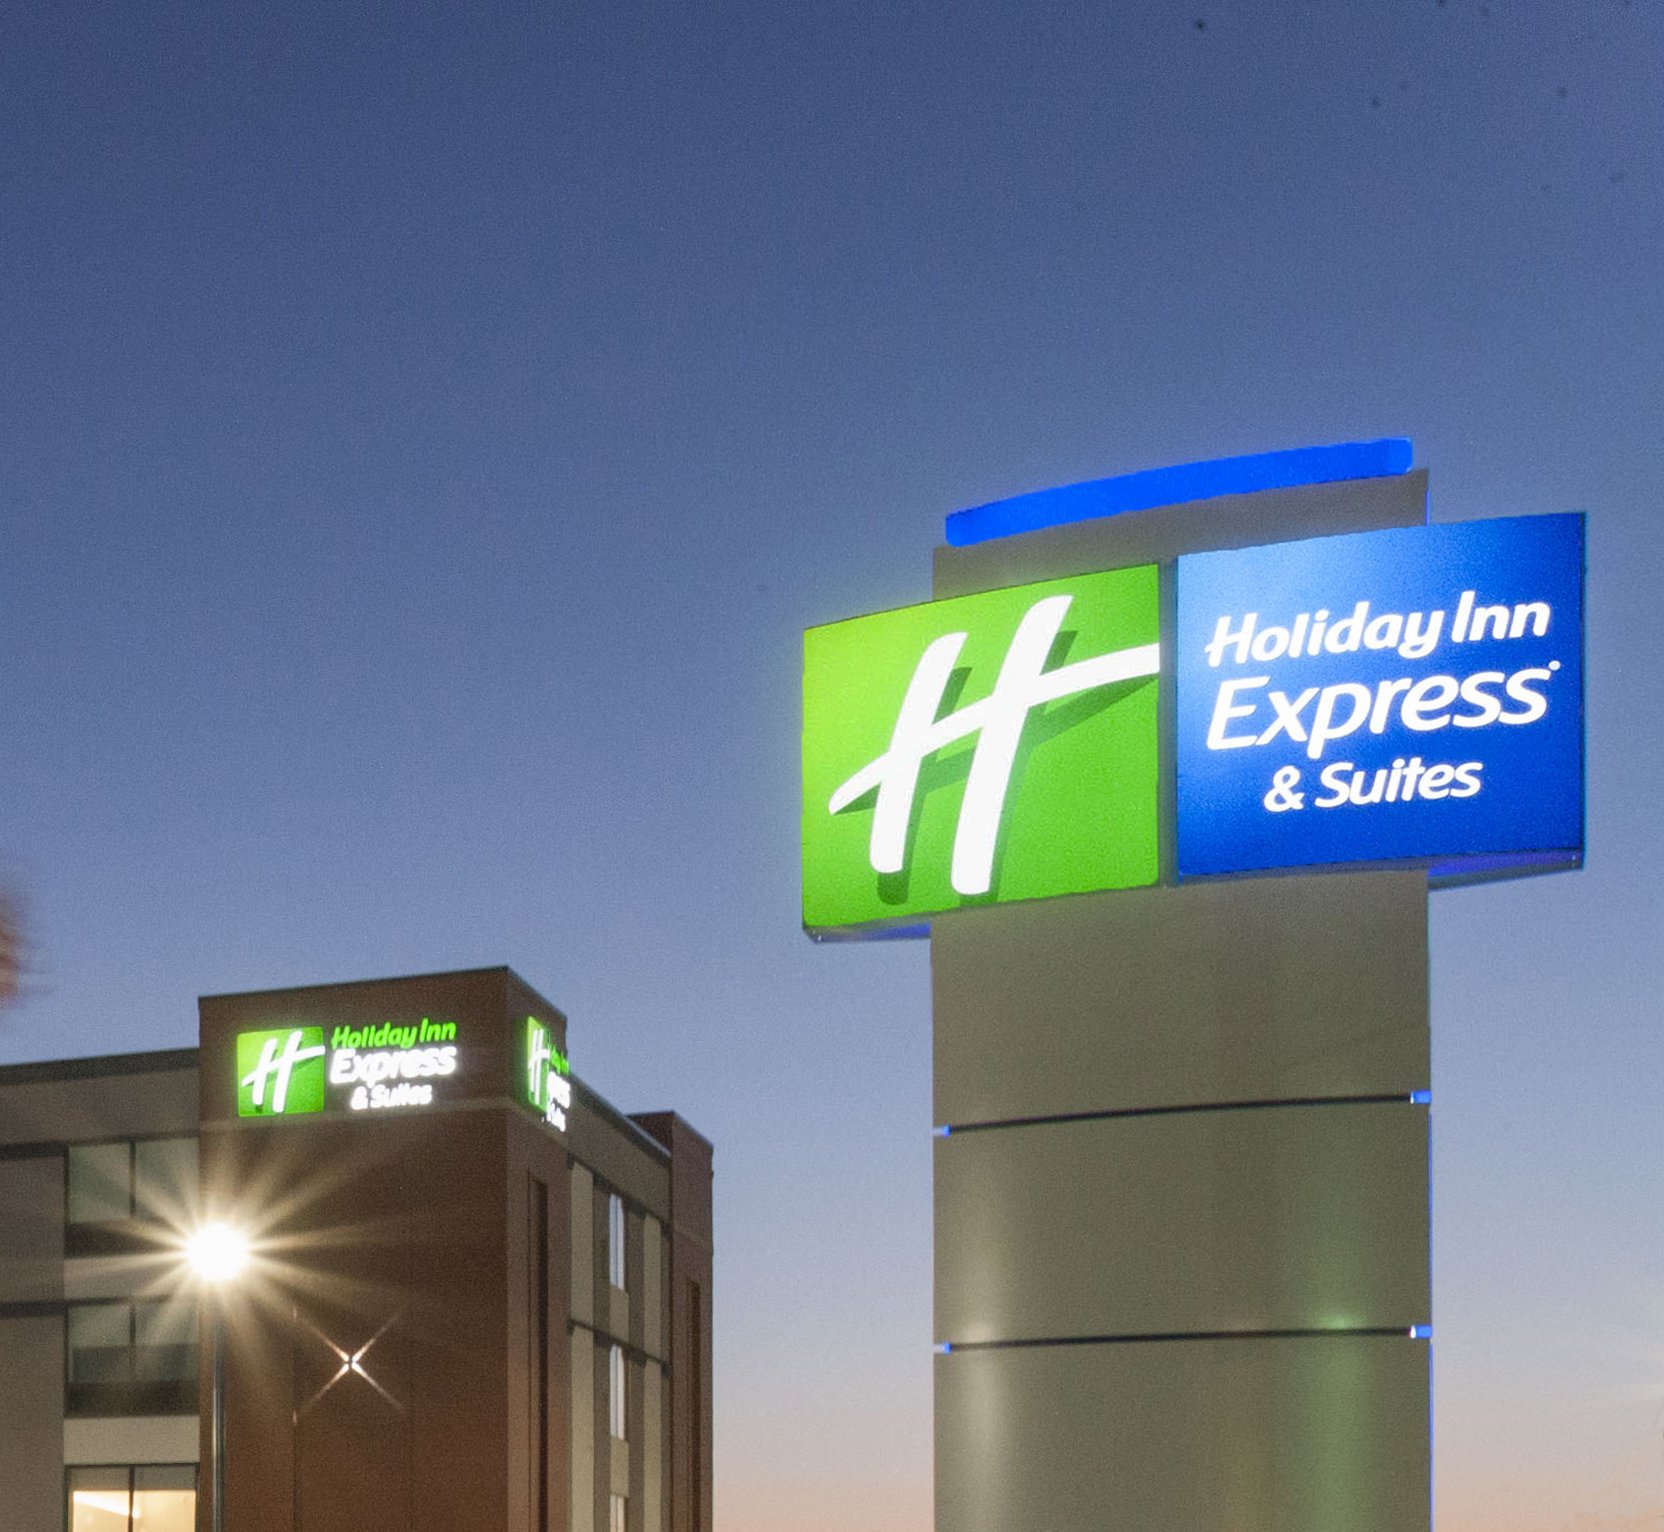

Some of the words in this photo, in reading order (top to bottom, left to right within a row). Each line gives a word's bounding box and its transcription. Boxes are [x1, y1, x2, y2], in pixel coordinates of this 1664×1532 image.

[1204, 601, 1445, 668] Holiday
[1451, 590, 1551, 643] Inn
[1205, 667, 1554, 760] Express
[1263, 765, 1305, 813] &
[1314, 757, 1483, 808] Suites
[331, 1021, 418, 1051] Holiday
[419, 1017, 457, 1043] Inn
[330, 1045, 458, 1089] Express
